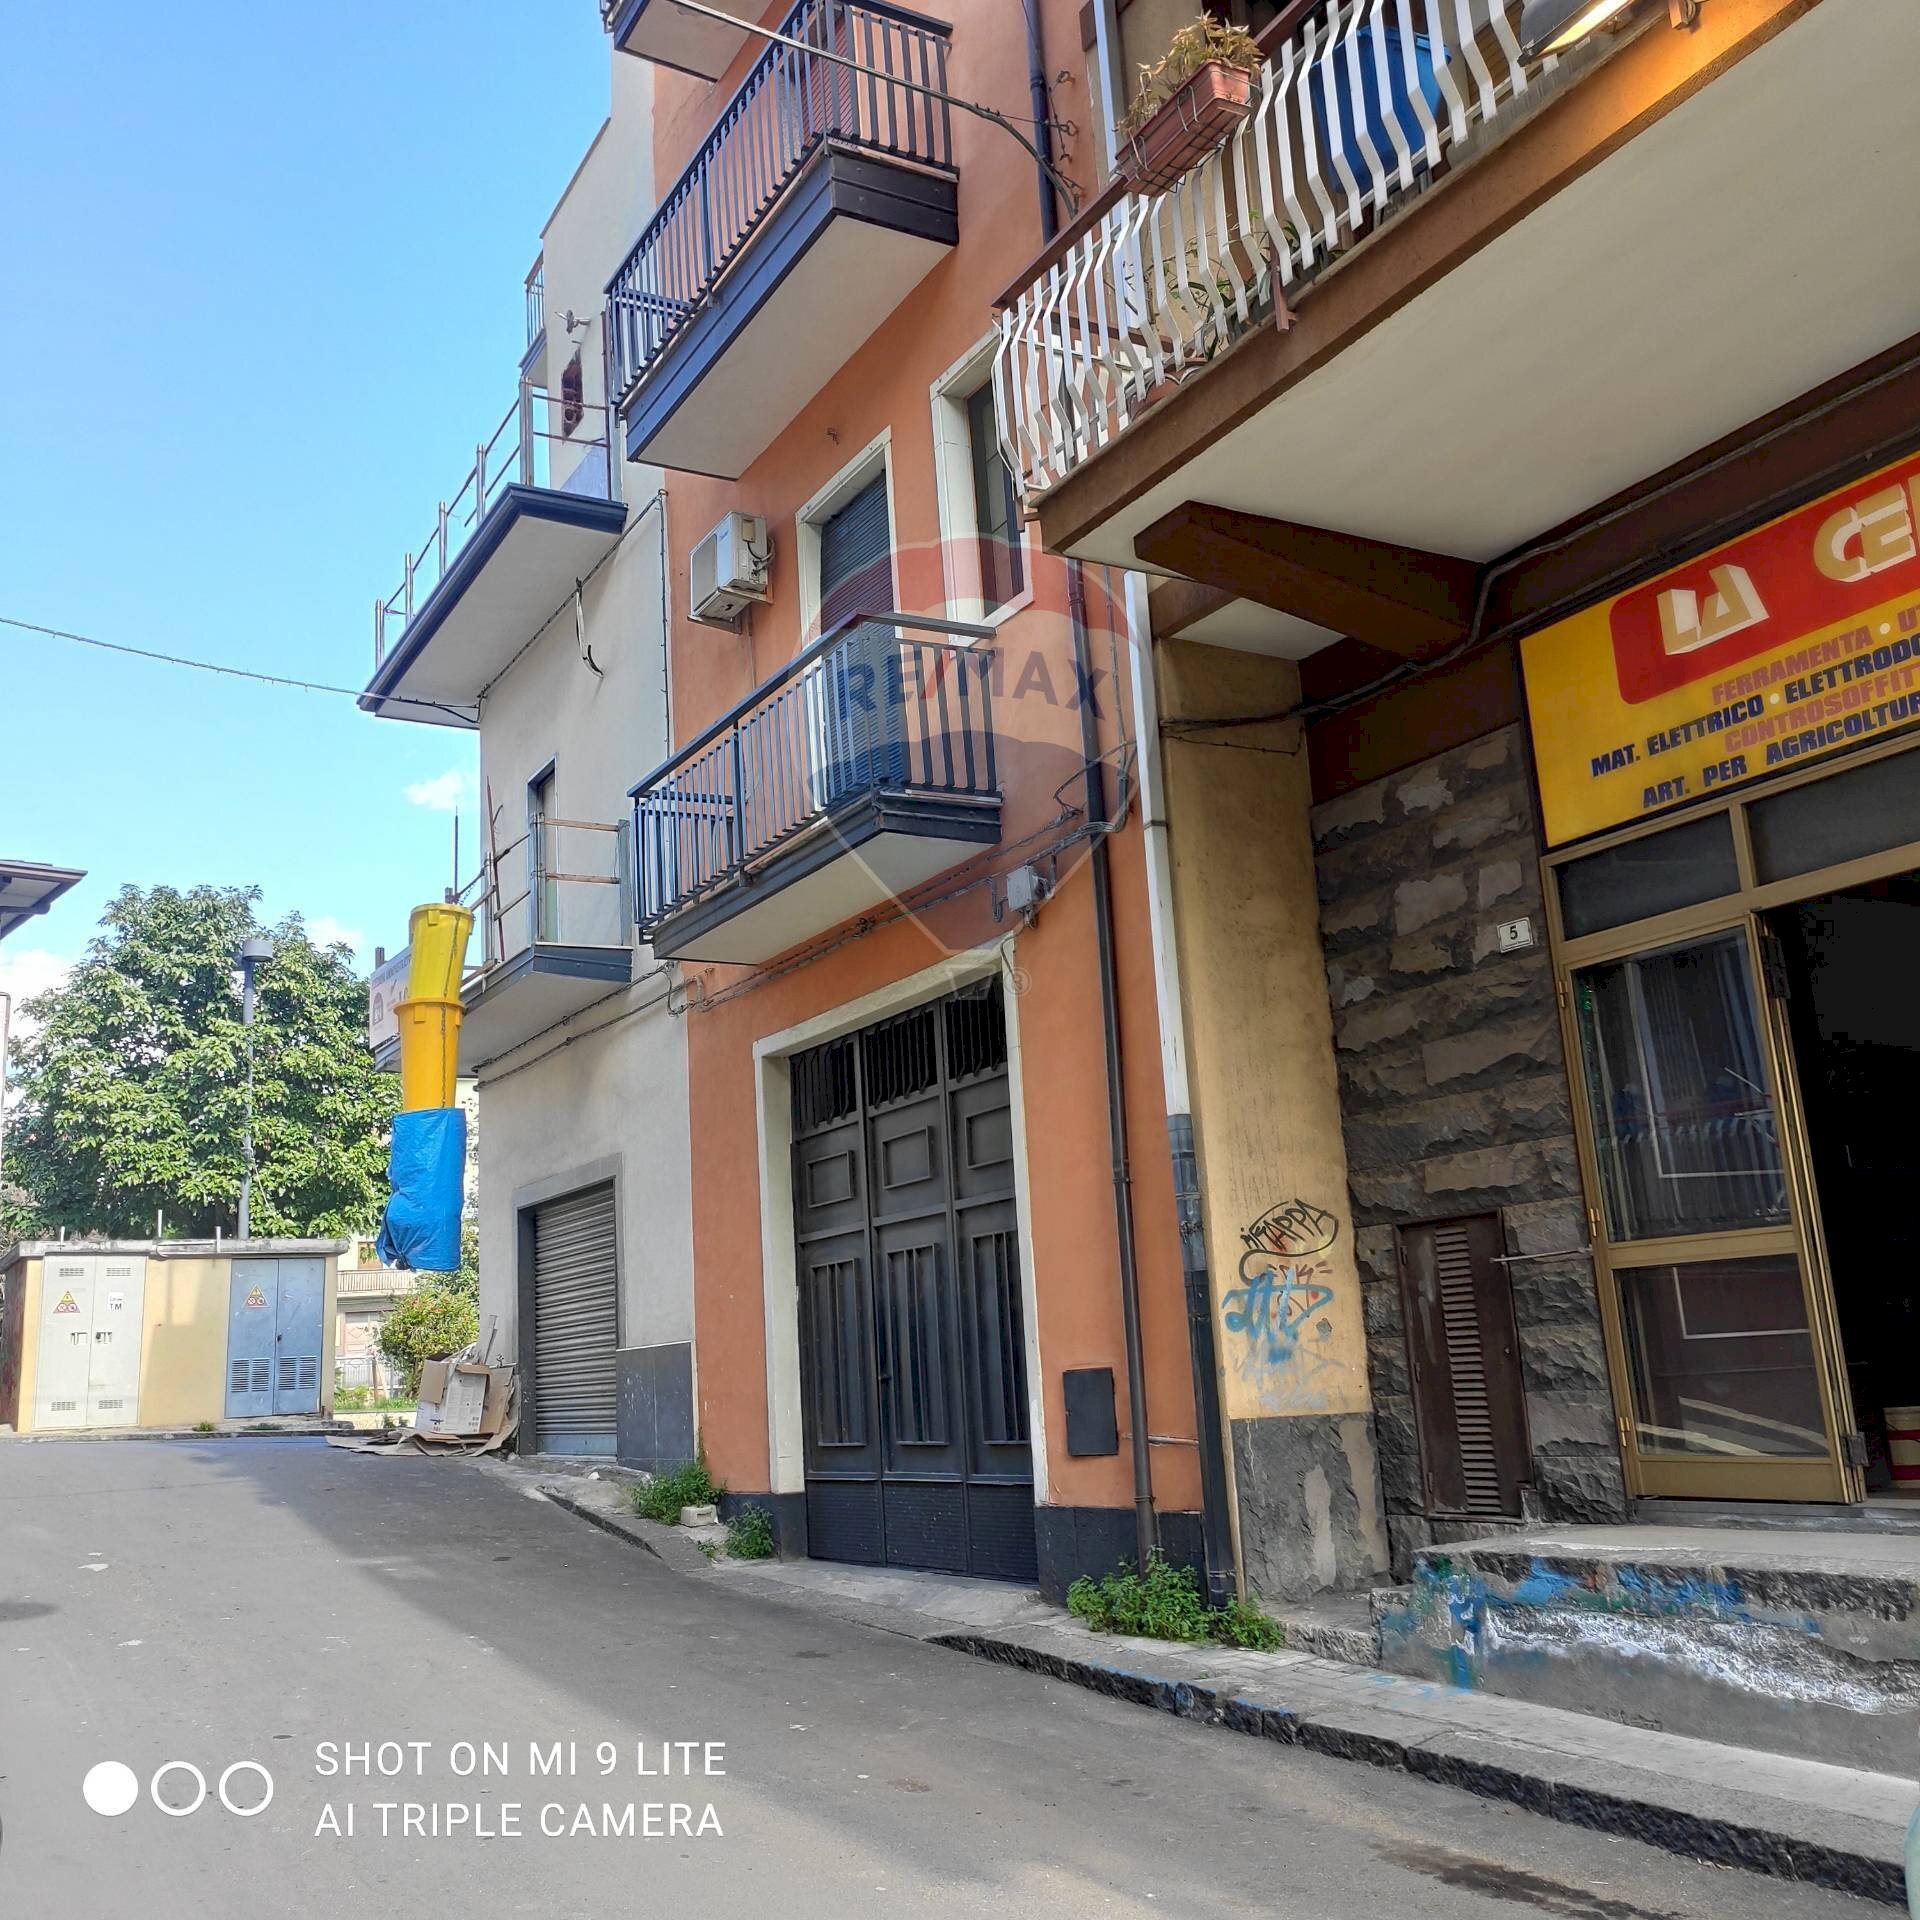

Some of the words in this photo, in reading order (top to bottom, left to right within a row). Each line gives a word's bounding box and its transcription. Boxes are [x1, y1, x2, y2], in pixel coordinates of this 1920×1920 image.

[1656, 563, 1770, 656] LA
[1813, 473, 1920, 583] CE
[1712, 625, 1875, 705] FERRAMENTA
[1590, 743, 1641, 778] MAT.
[1646, 694, 1765, 756] ELETTRICO
[1724, 664, 1920, 752] CONTROSOFFIT
[1643, 776, 1691, 809] ART.
[1703, 754, 1748, 787] PER
[1510, 925, 1518, 940] 5
